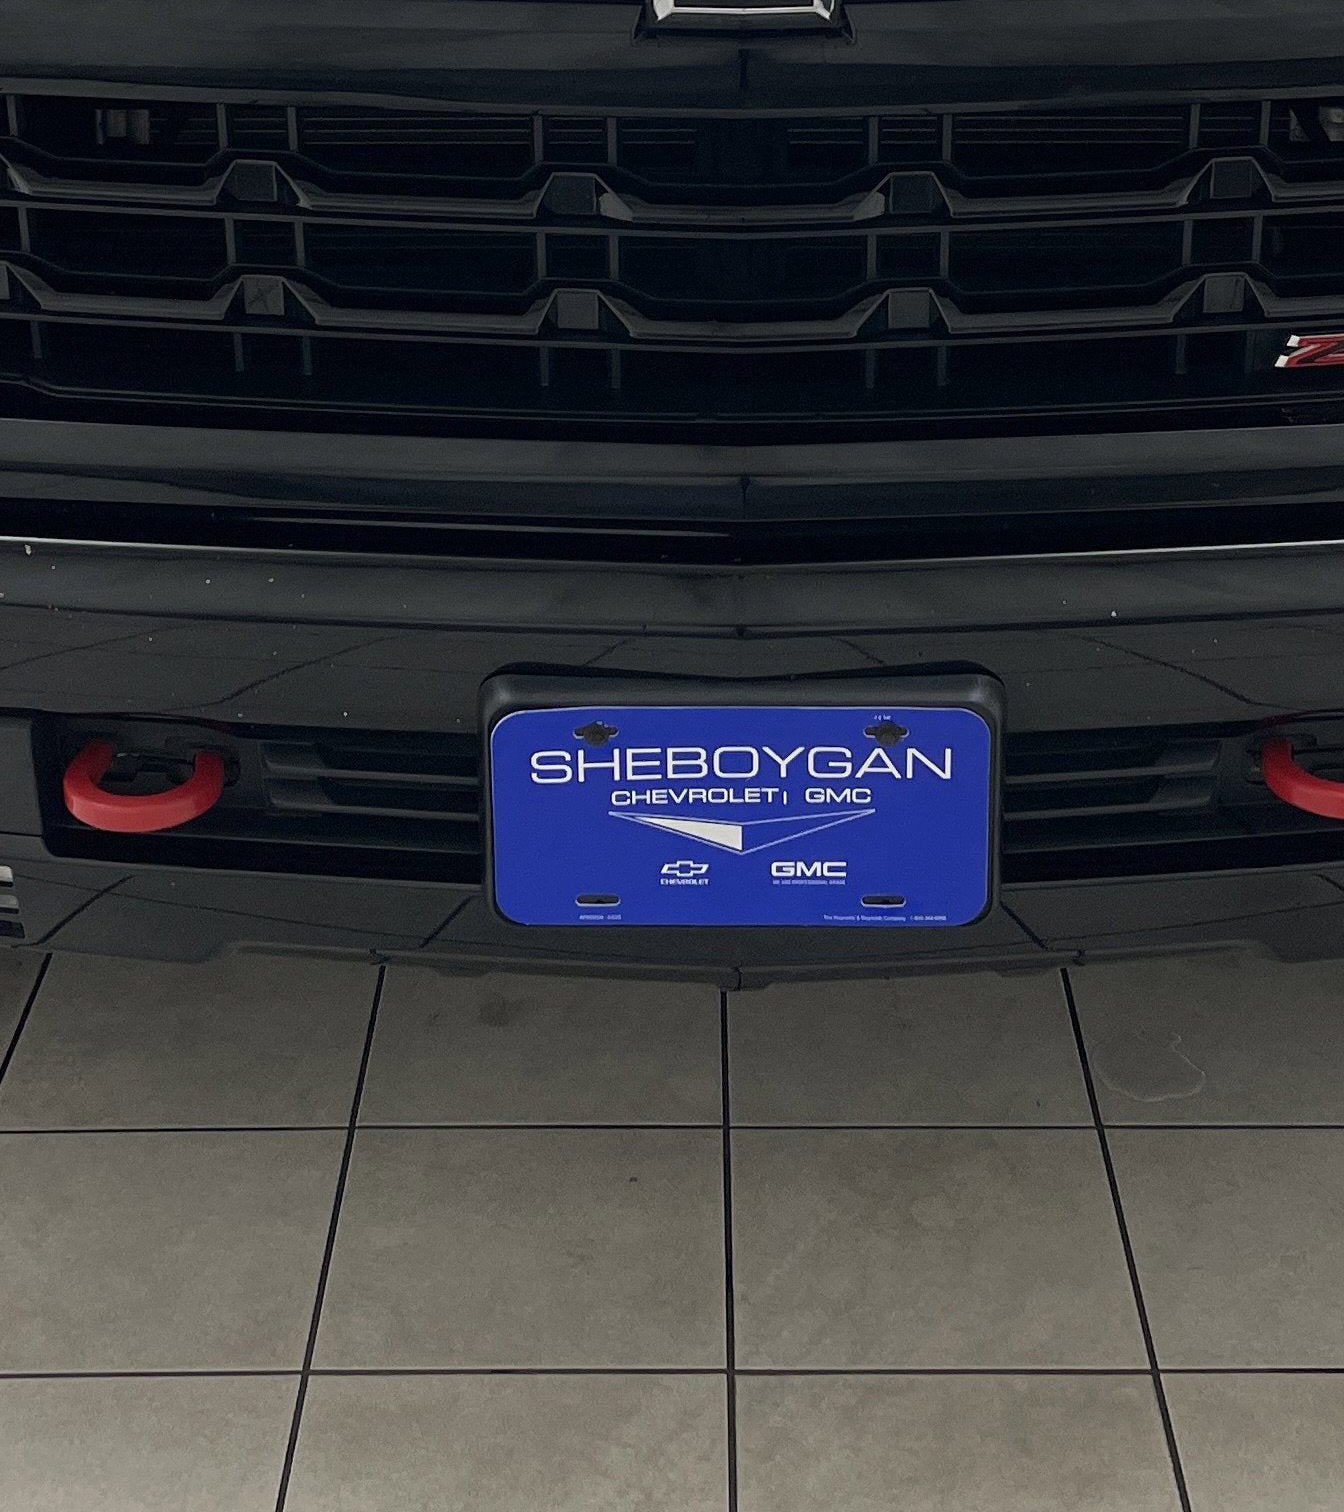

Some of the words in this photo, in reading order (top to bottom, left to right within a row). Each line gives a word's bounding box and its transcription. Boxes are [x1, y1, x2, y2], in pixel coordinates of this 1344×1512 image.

[530, 746, 952, 784] SHEBOYGAN
[611, 787, 779, 806] CHEVROLET
[805, 788, 872, 804] GMC
[770, 861, 847, 877] GMC
[660, 878, 709, 886] CHEVROLET
